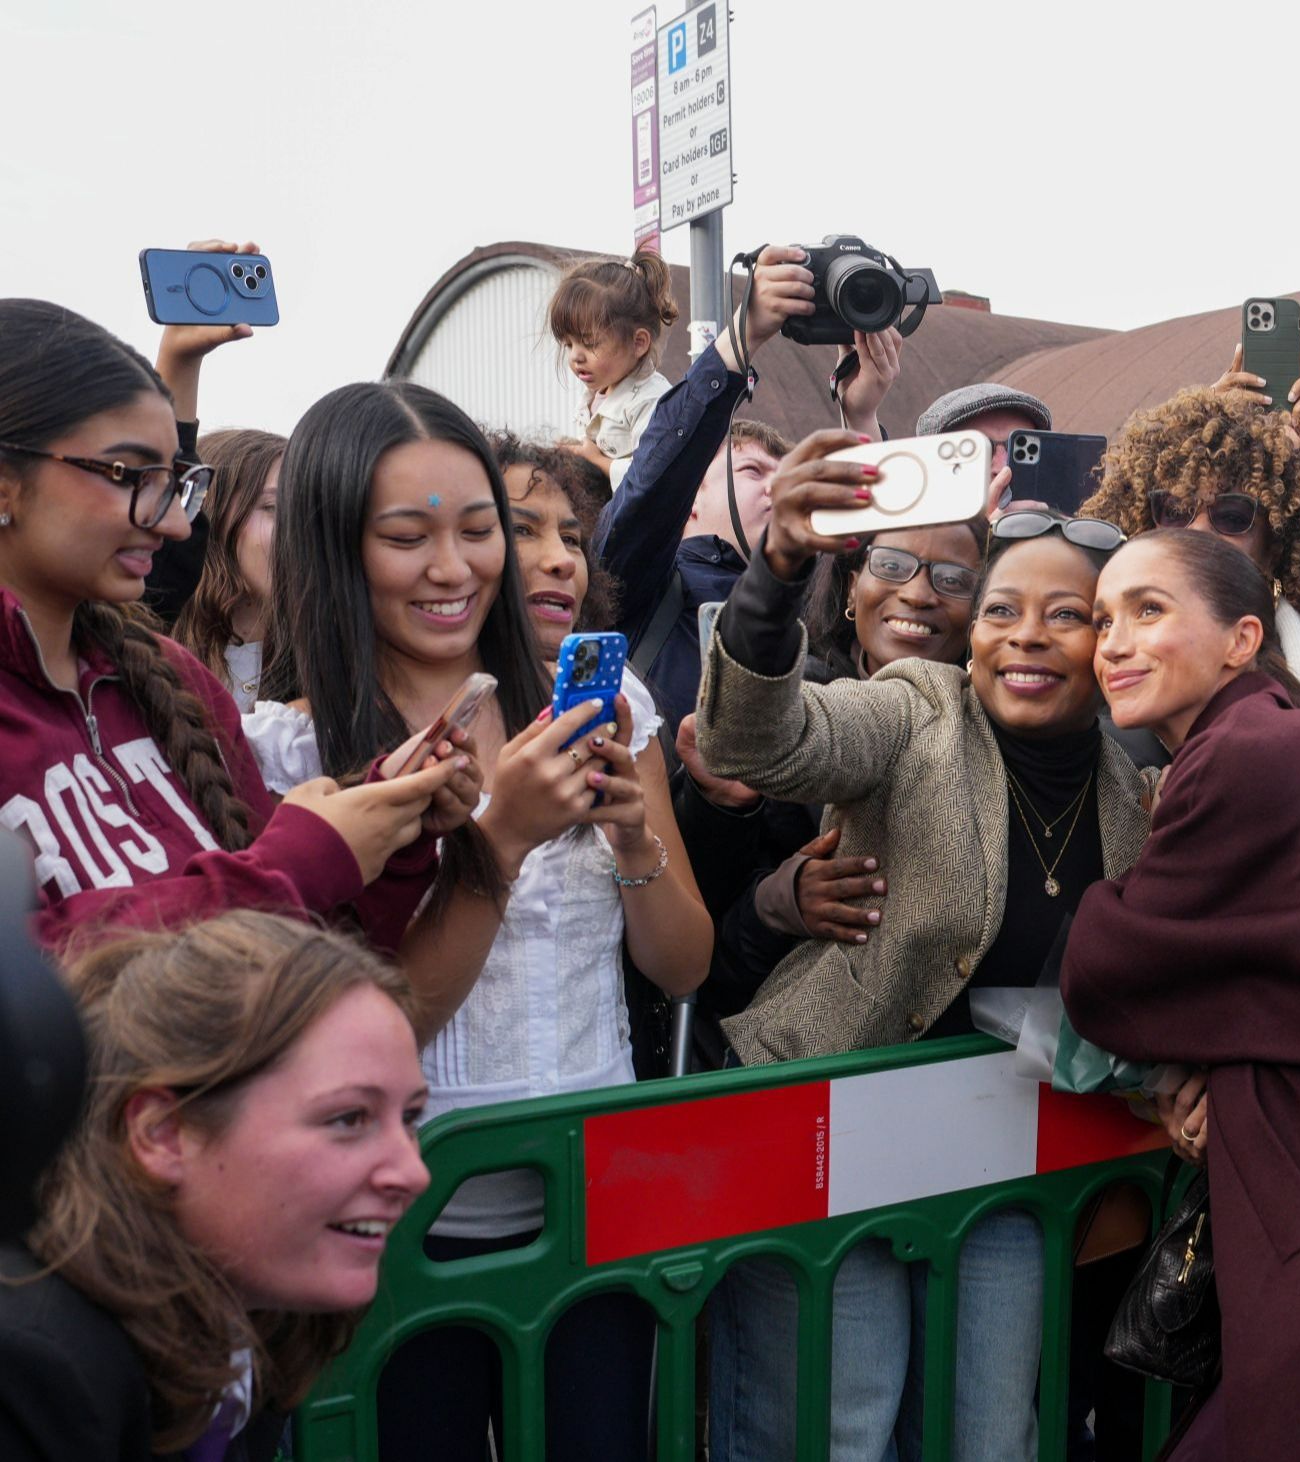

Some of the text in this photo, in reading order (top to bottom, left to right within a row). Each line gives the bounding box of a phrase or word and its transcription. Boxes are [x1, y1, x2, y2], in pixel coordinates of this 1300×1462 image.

[671, 29, 684, 70] P
[700, 18, 714, 45] Z4
[673, 81, 679, 95] 8
[679, 78, 690, 92] am
[695, 69, 700, 82] 6
[701, 65, 713, 82] pm
[663, 106, 686, 128] Permit
[688, 92, 715, 116] holders
[689, 126, 697, 139] or
[662, 157, 679, 175] Card
[681, 144, 708, 166] holders
[711, 132, 727, 155] 1GF
[690, 173, 698, 186] or
[672, 189, 720, 218] Pay by phone
[0, 737, 220, 898] BOST
[816, 1130, 824, 1190] BS8442-2015
